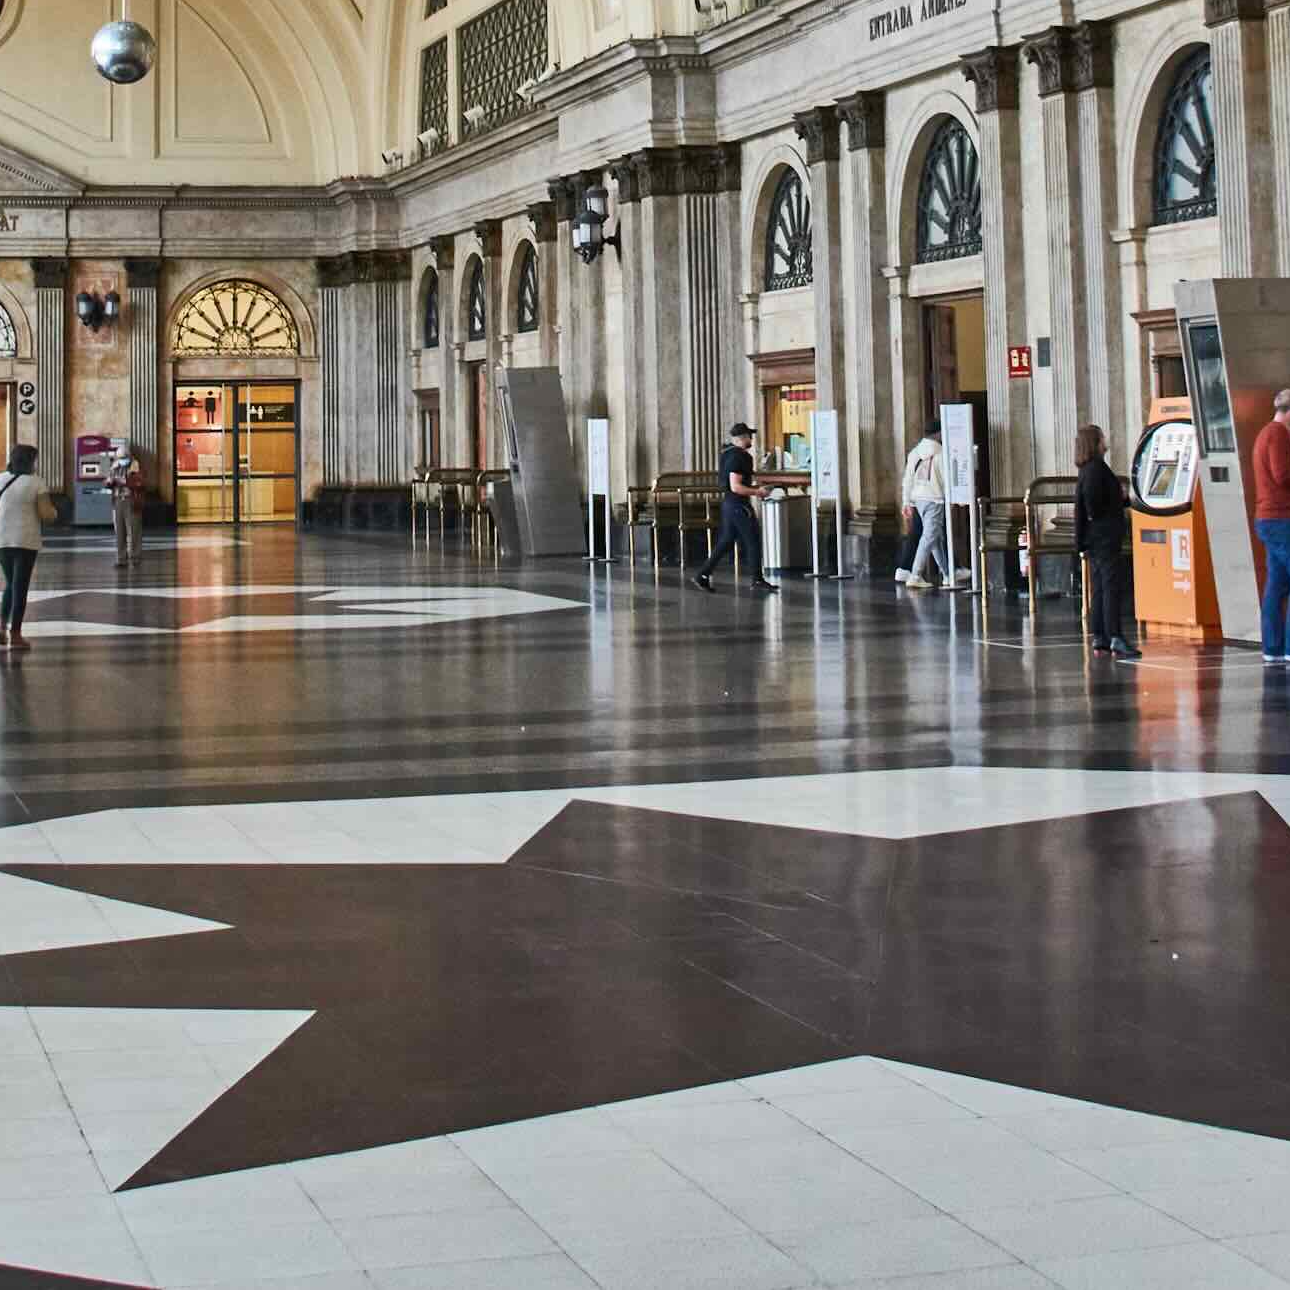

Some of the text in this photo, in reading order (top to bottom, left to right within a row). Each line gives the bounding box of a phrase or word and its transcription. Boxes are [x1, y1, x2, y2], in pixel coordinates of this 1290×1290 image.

[869, 4, 913, 41] ENTRADA
[23, 384, 32, 395] P
[1180, 535, 1190, 558] R
